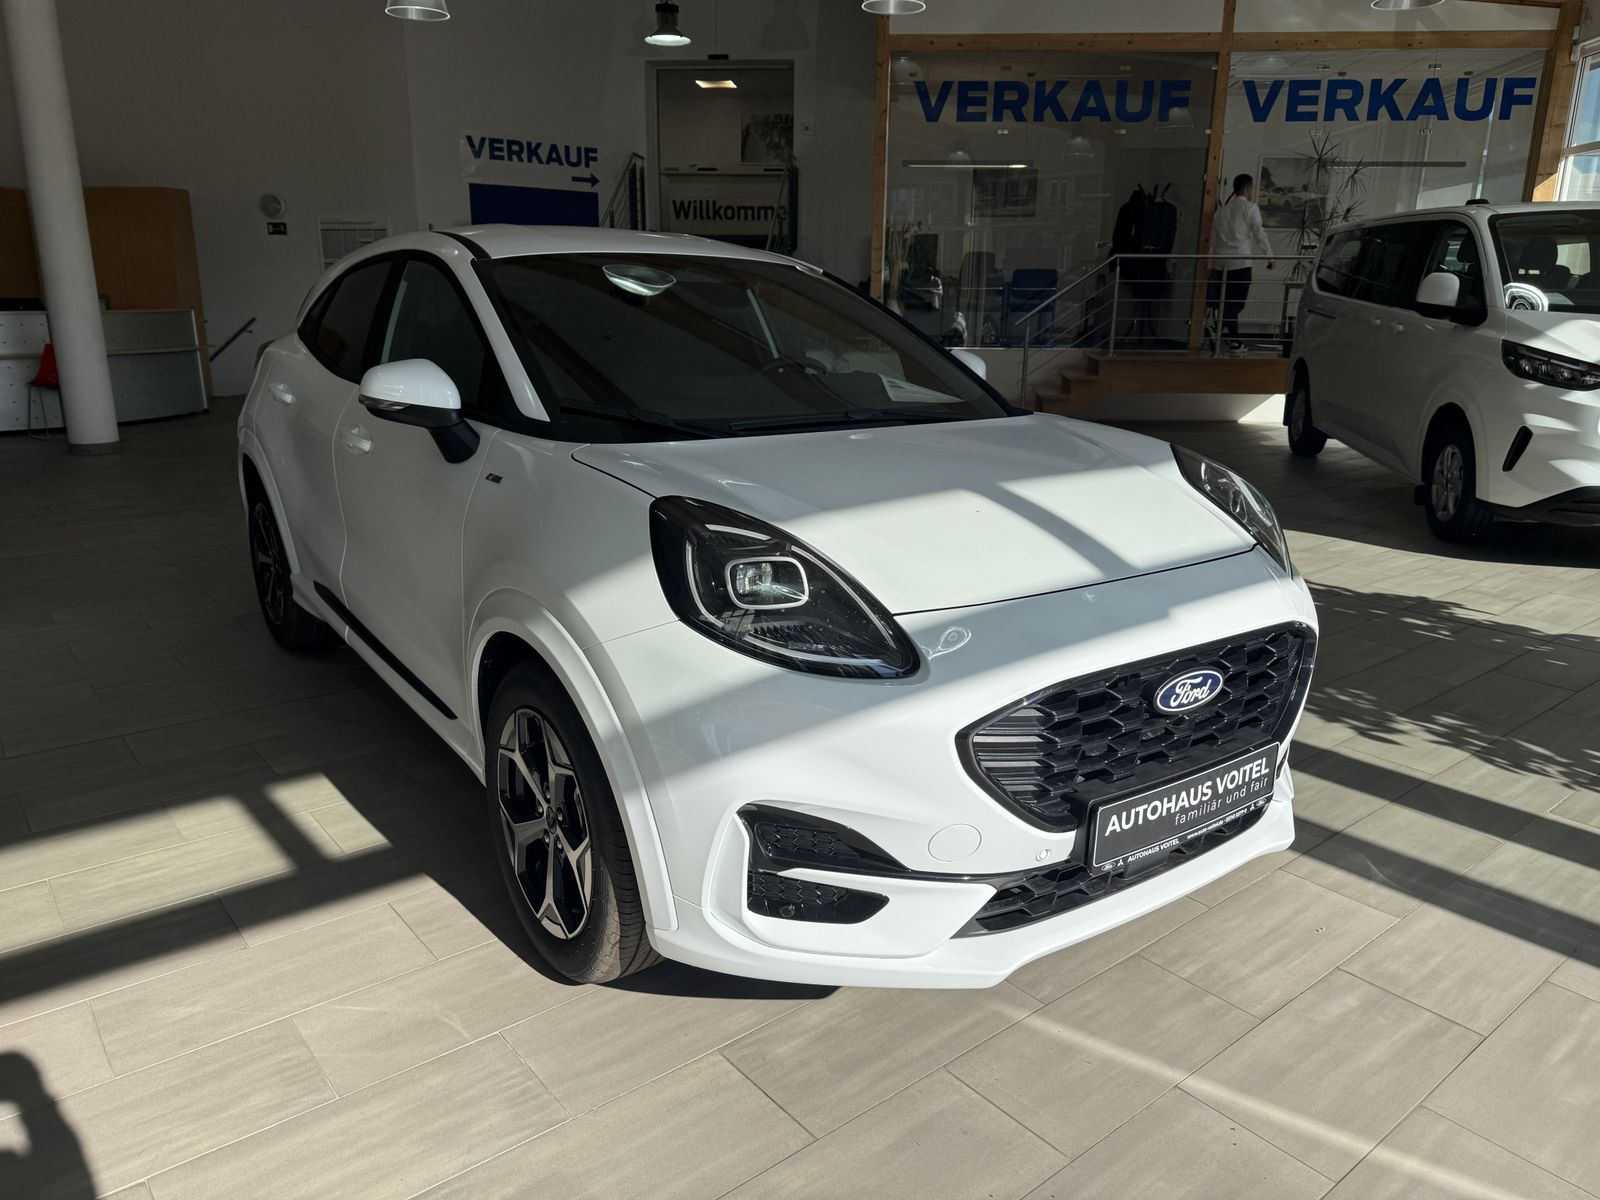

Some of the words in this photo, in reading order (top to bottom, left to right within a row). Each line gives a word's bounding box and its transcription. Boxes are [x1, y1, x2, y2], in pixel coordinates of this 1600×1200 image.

[913, 79, 1193, 123] VERKAUF
[1243, 77, 1537, 122] VERKAUF
[465, 134, 598, 169] VERKAUF
[1170, 676, 1211, 707] Ford
[1104, 781, 1213, 837] AUTOHAUS
[1215, 757, 1270, 794] VOITEL
[1174, 797, 1222, 827] familiär
[1226, 786, 1247, 805] und
[1250, 776, 1269, 794] fair
[1127, 845, 1160, 863] AUTOHAUS
